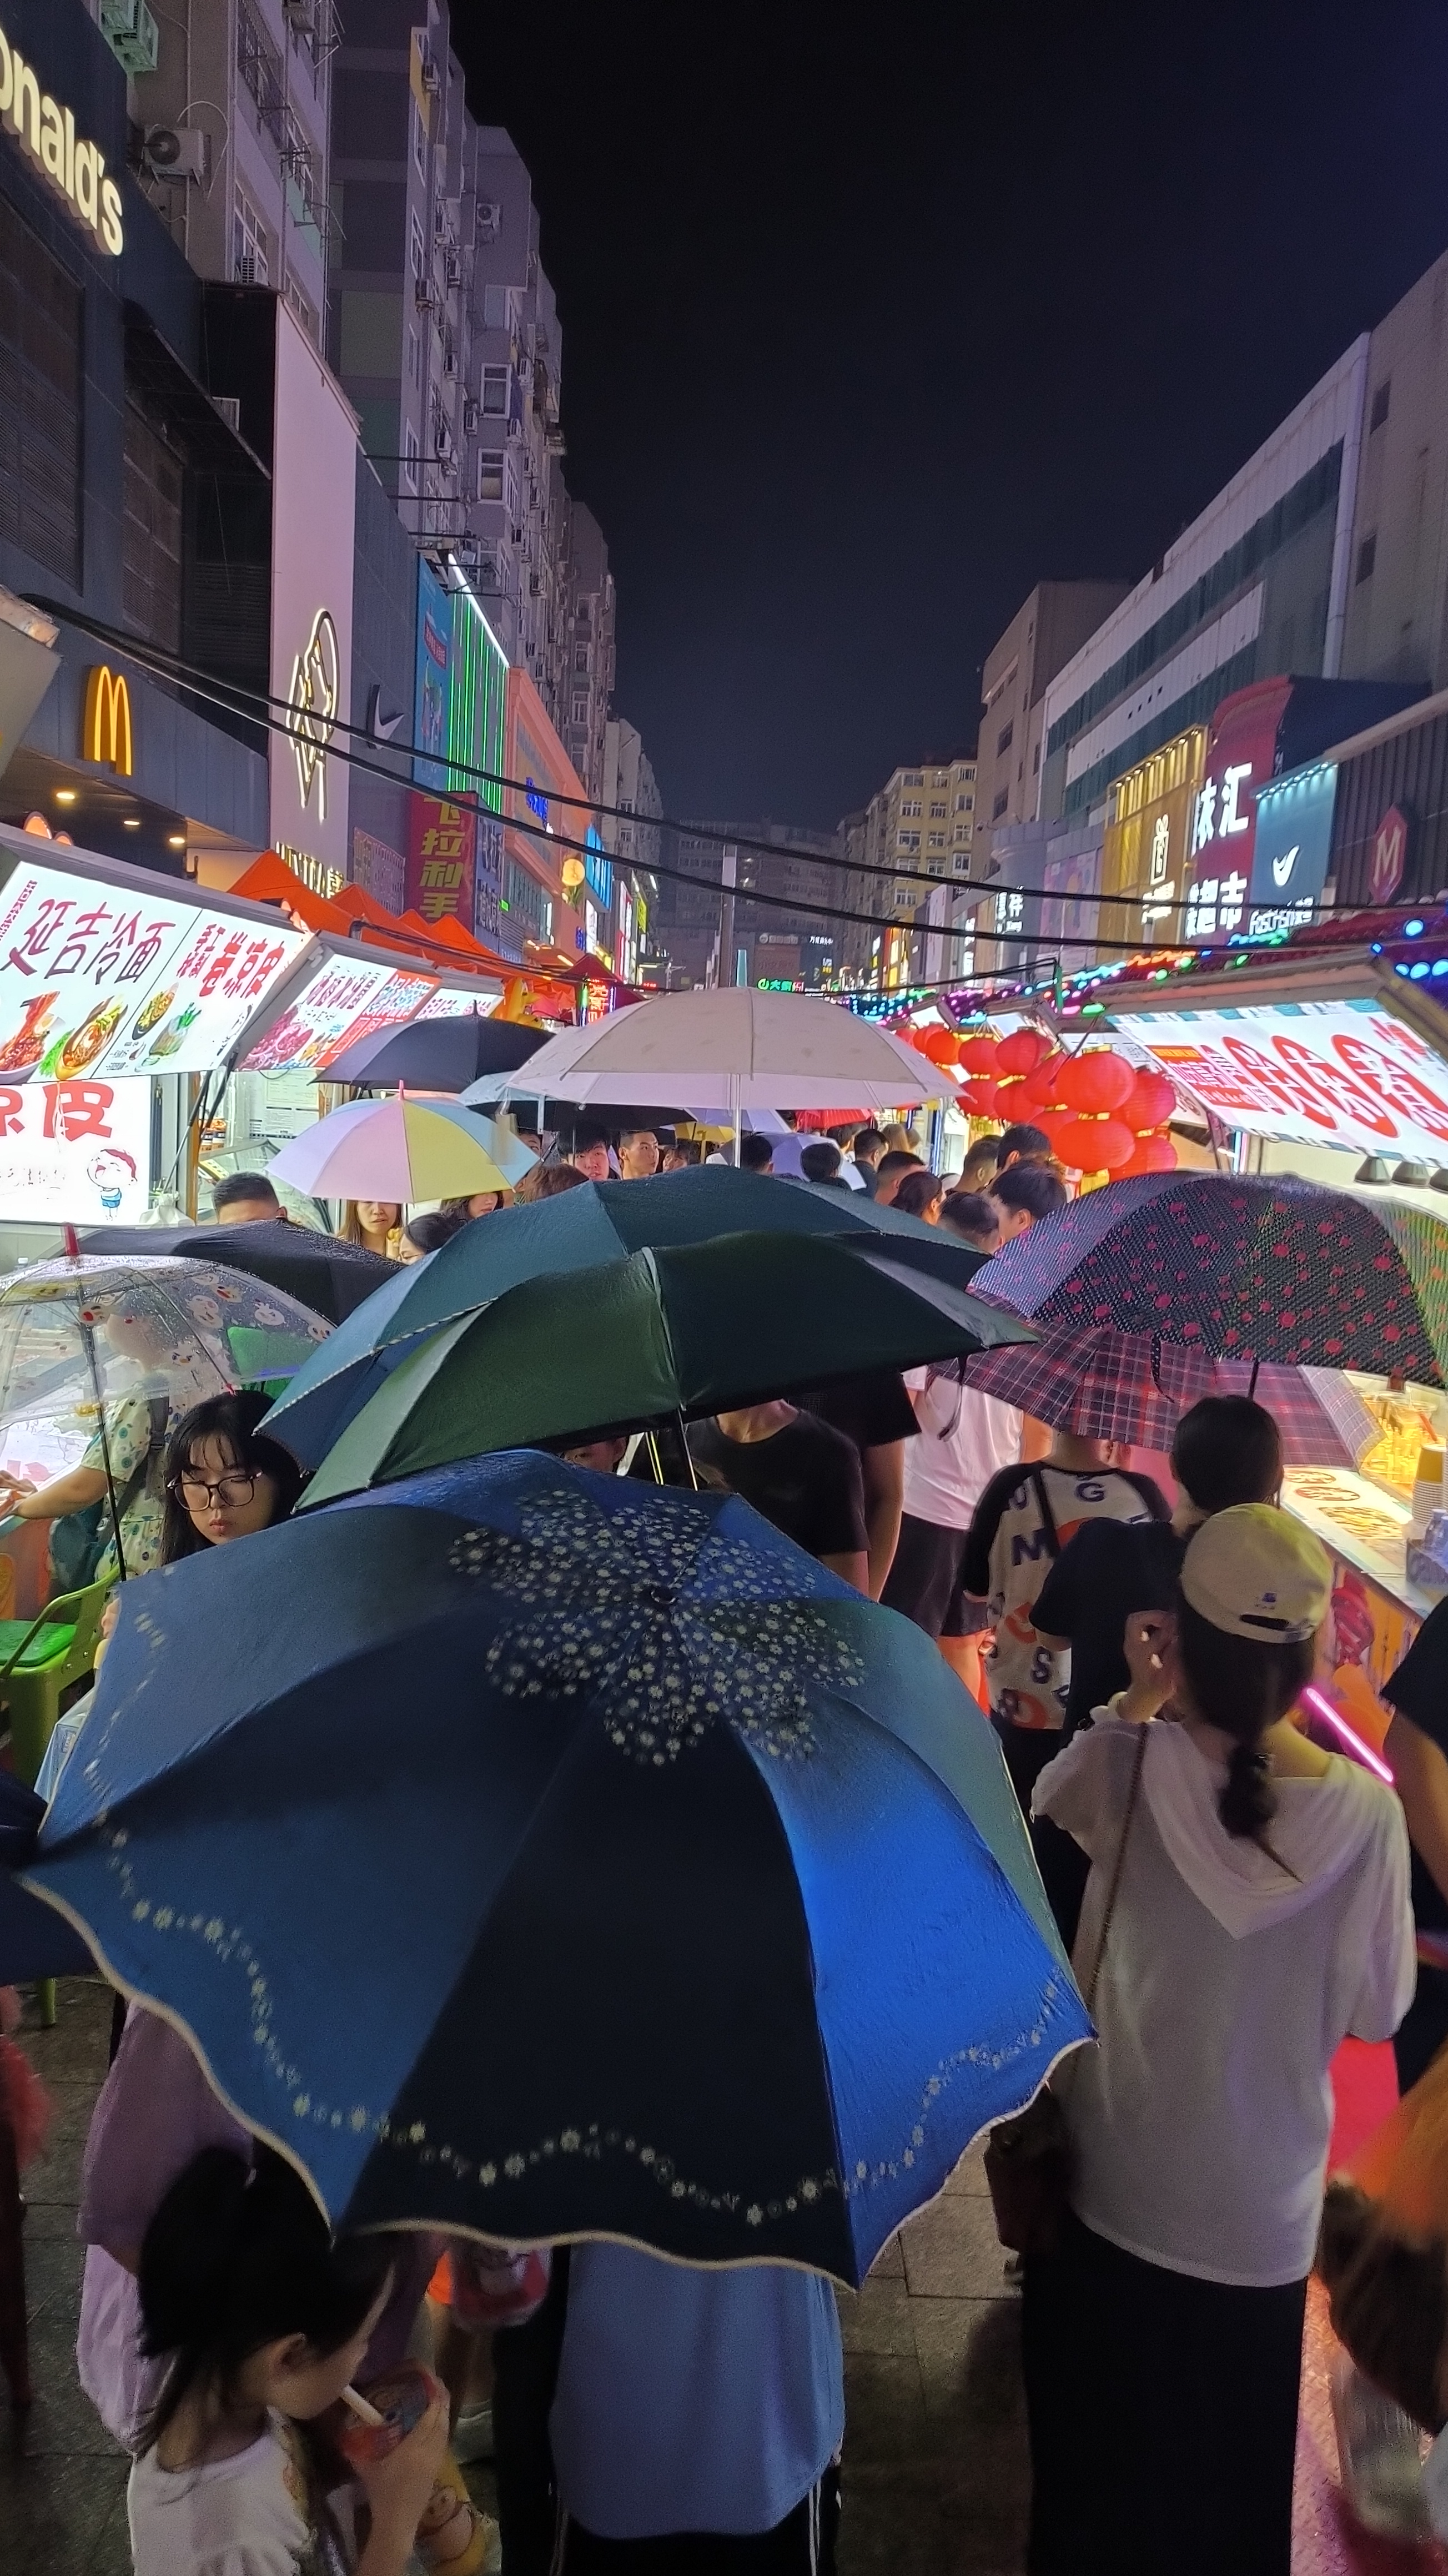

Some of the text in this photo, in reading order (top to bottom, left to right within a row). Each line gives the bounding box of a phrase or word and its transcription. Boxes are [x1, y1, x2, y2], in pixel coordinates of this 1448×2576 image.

[0, 898, 177, 985] 延吉冷面
[1228, 1043, 1448, 1129] 关东煮
